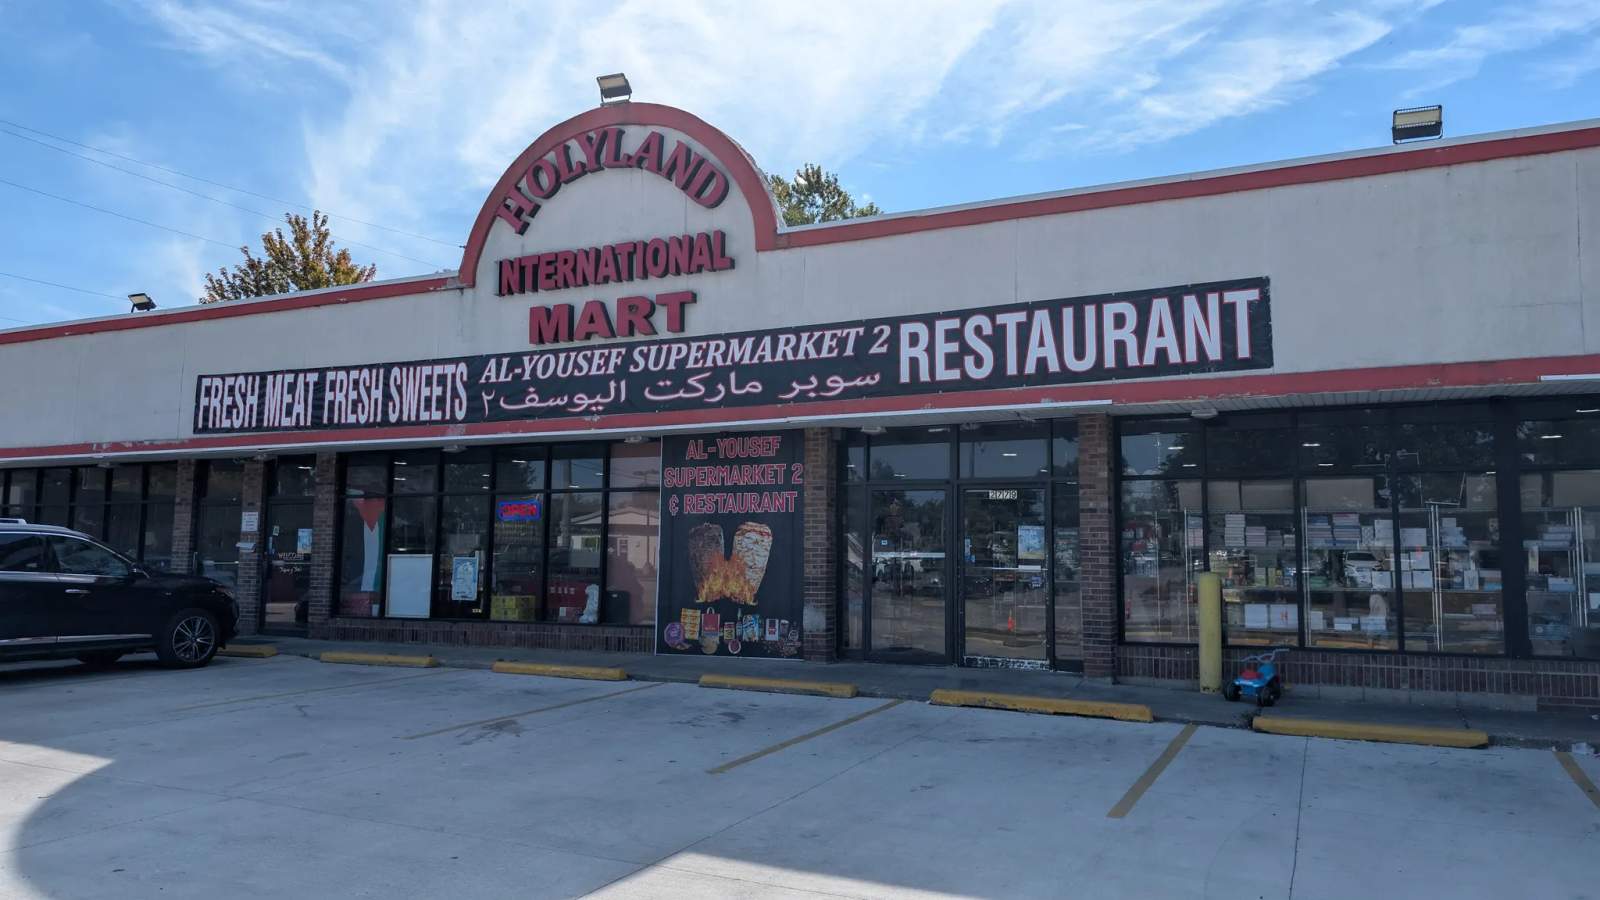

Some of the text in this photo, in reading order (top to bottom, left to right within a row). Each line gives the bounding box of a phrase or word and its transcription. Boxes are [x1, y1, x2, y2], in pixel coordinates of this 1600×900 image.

[496, 127, 730, 236] HOLYLAND
[528, 290, 698, 345] MART
[898, 288, 1261, 385] RESTAURANT
[479, 324, 891, 384] AL-YOUSEF SUPERMARKET 2
[198, 361, 468, 429] FRESH MEAT FRESH SWEETS
[499, 379, 626, 412] اليوسف
[644, 370, 763, 402] ماركت
[778, 371, 881, 399] سوبر
[685, 436, 782, 461] AL-YOUSEF
[664, 463, 804, 488] SUPERMARKET 2
[683, 491, 798, 514] RESTAURANT
[989, 490, 1018, 500] 2779
